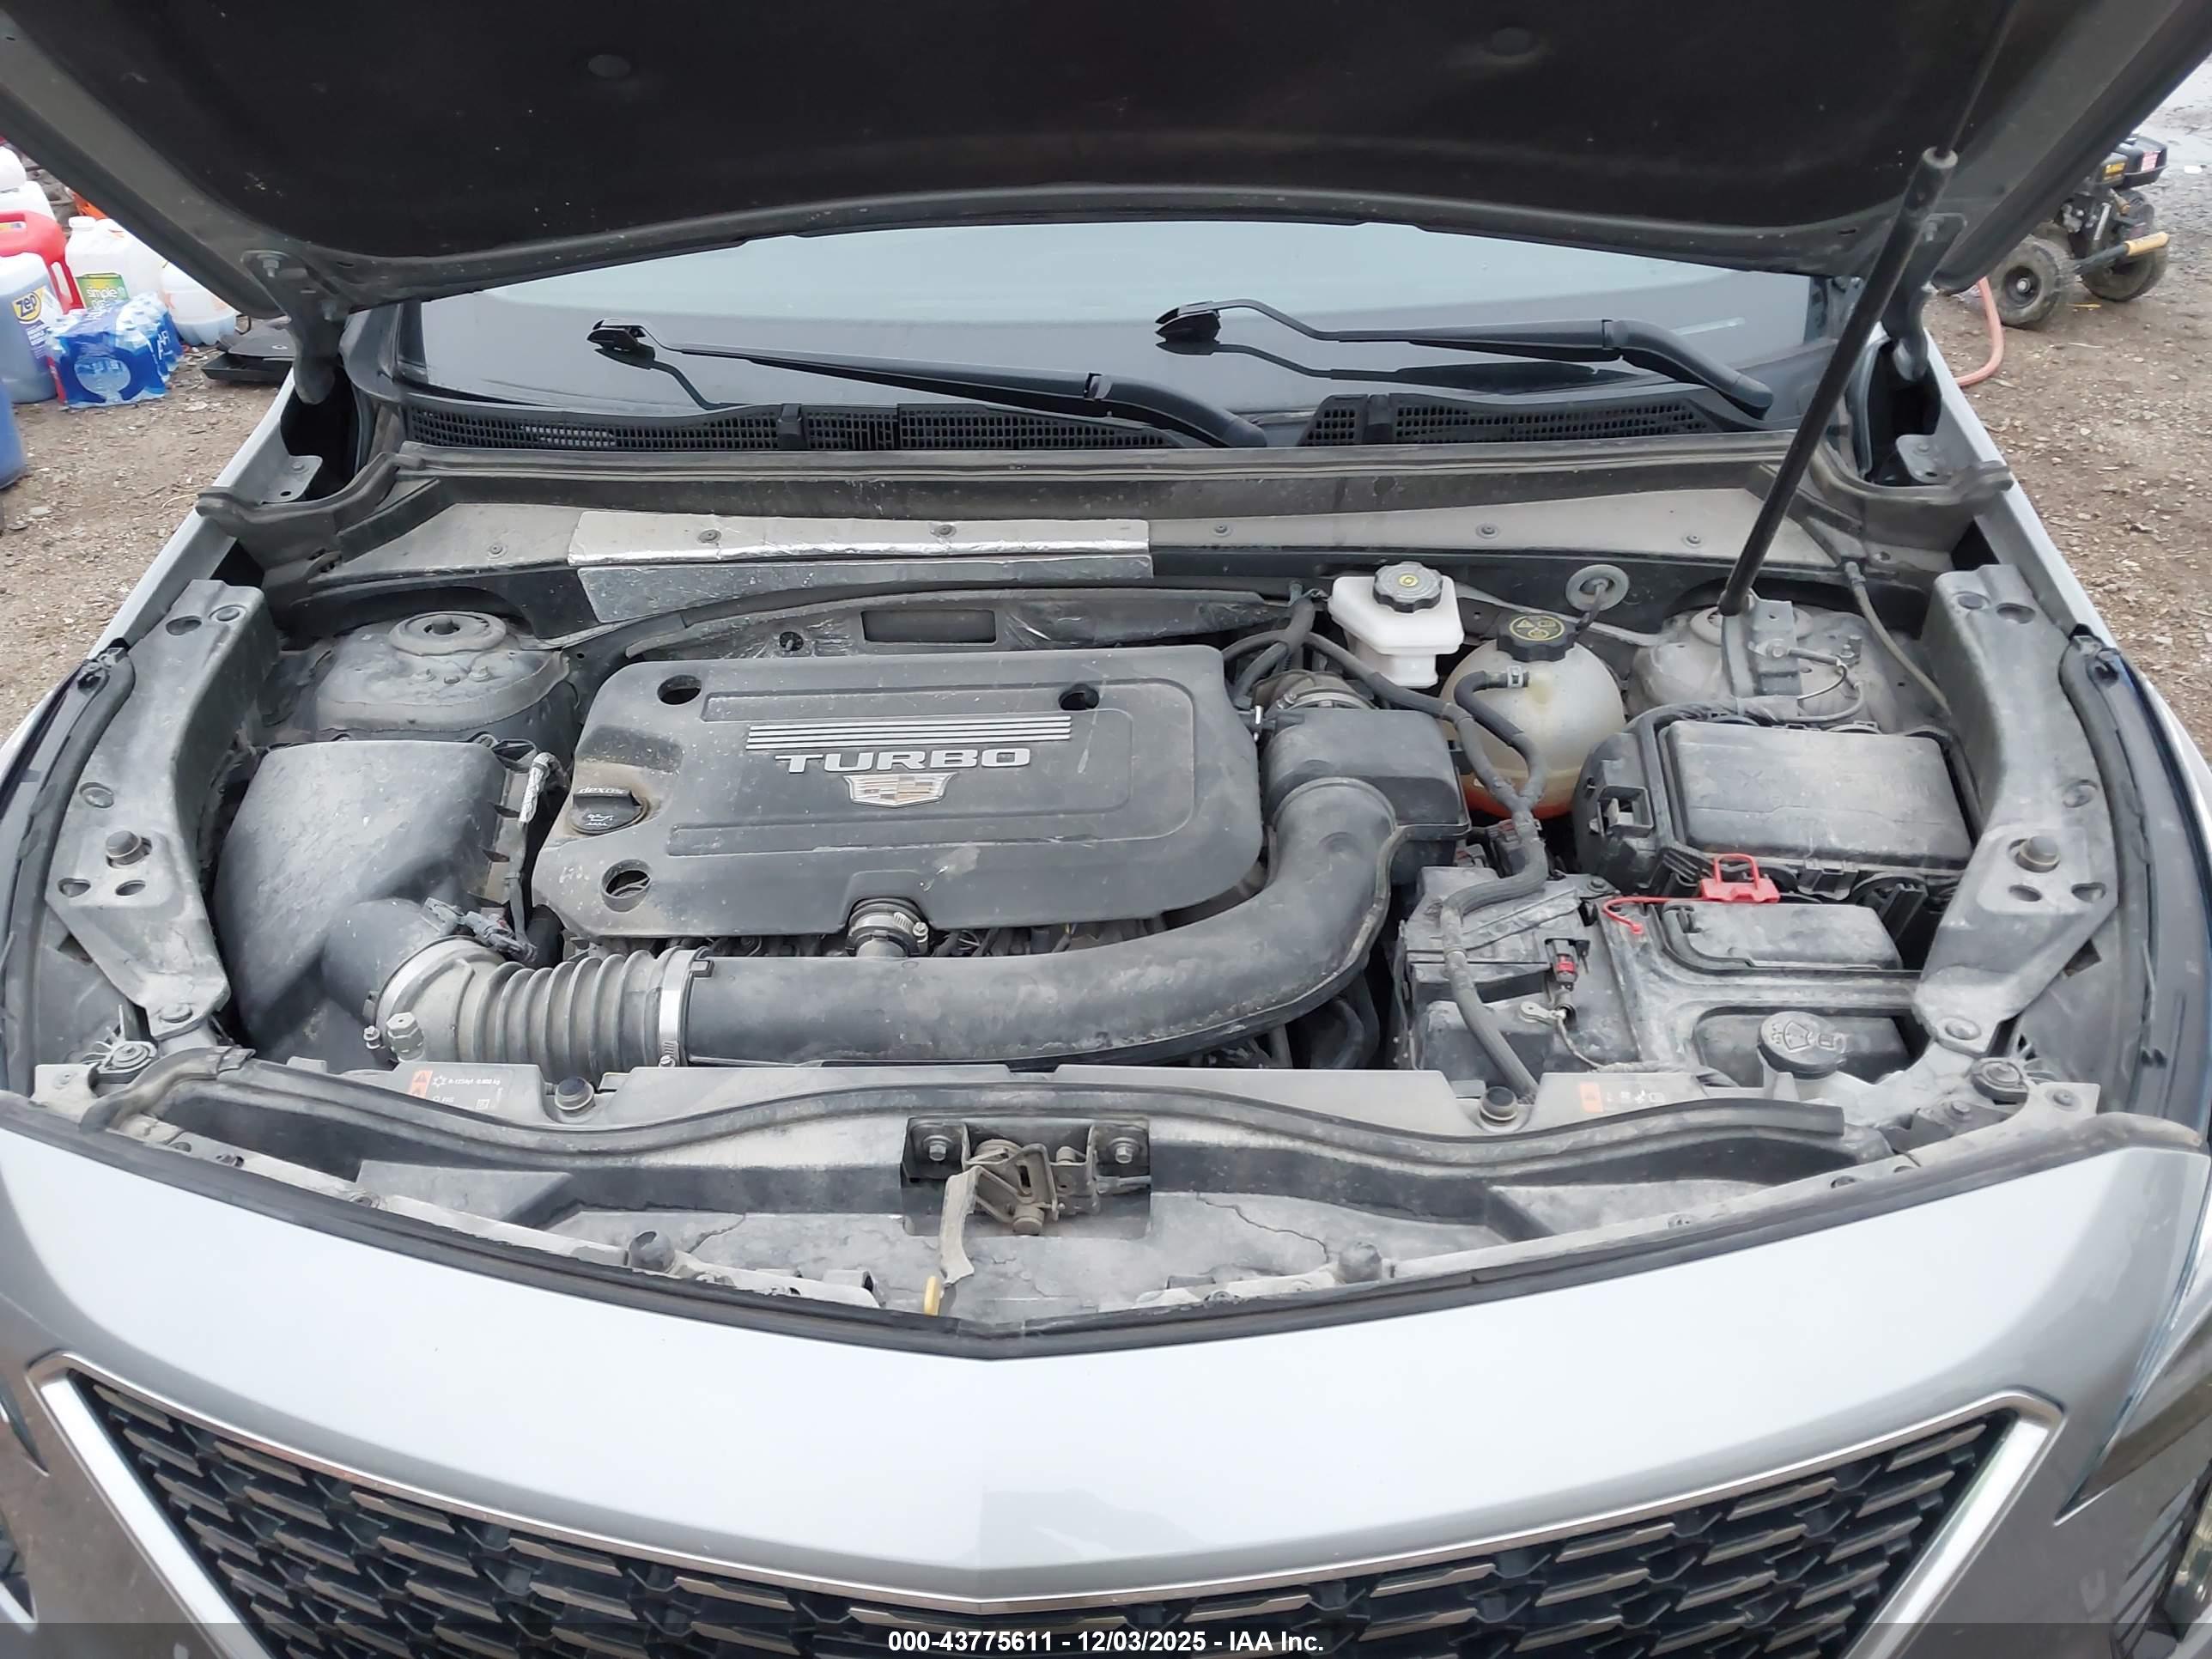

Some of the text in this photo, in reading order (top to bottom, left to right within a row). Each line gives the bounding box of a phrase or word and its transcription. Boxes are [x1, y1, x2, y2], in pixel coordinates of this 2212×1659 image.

[87, 287, 118, 300] simple
[775, 748, 1030, 773] TURBO
[576, 786, 626, 794] dexos
